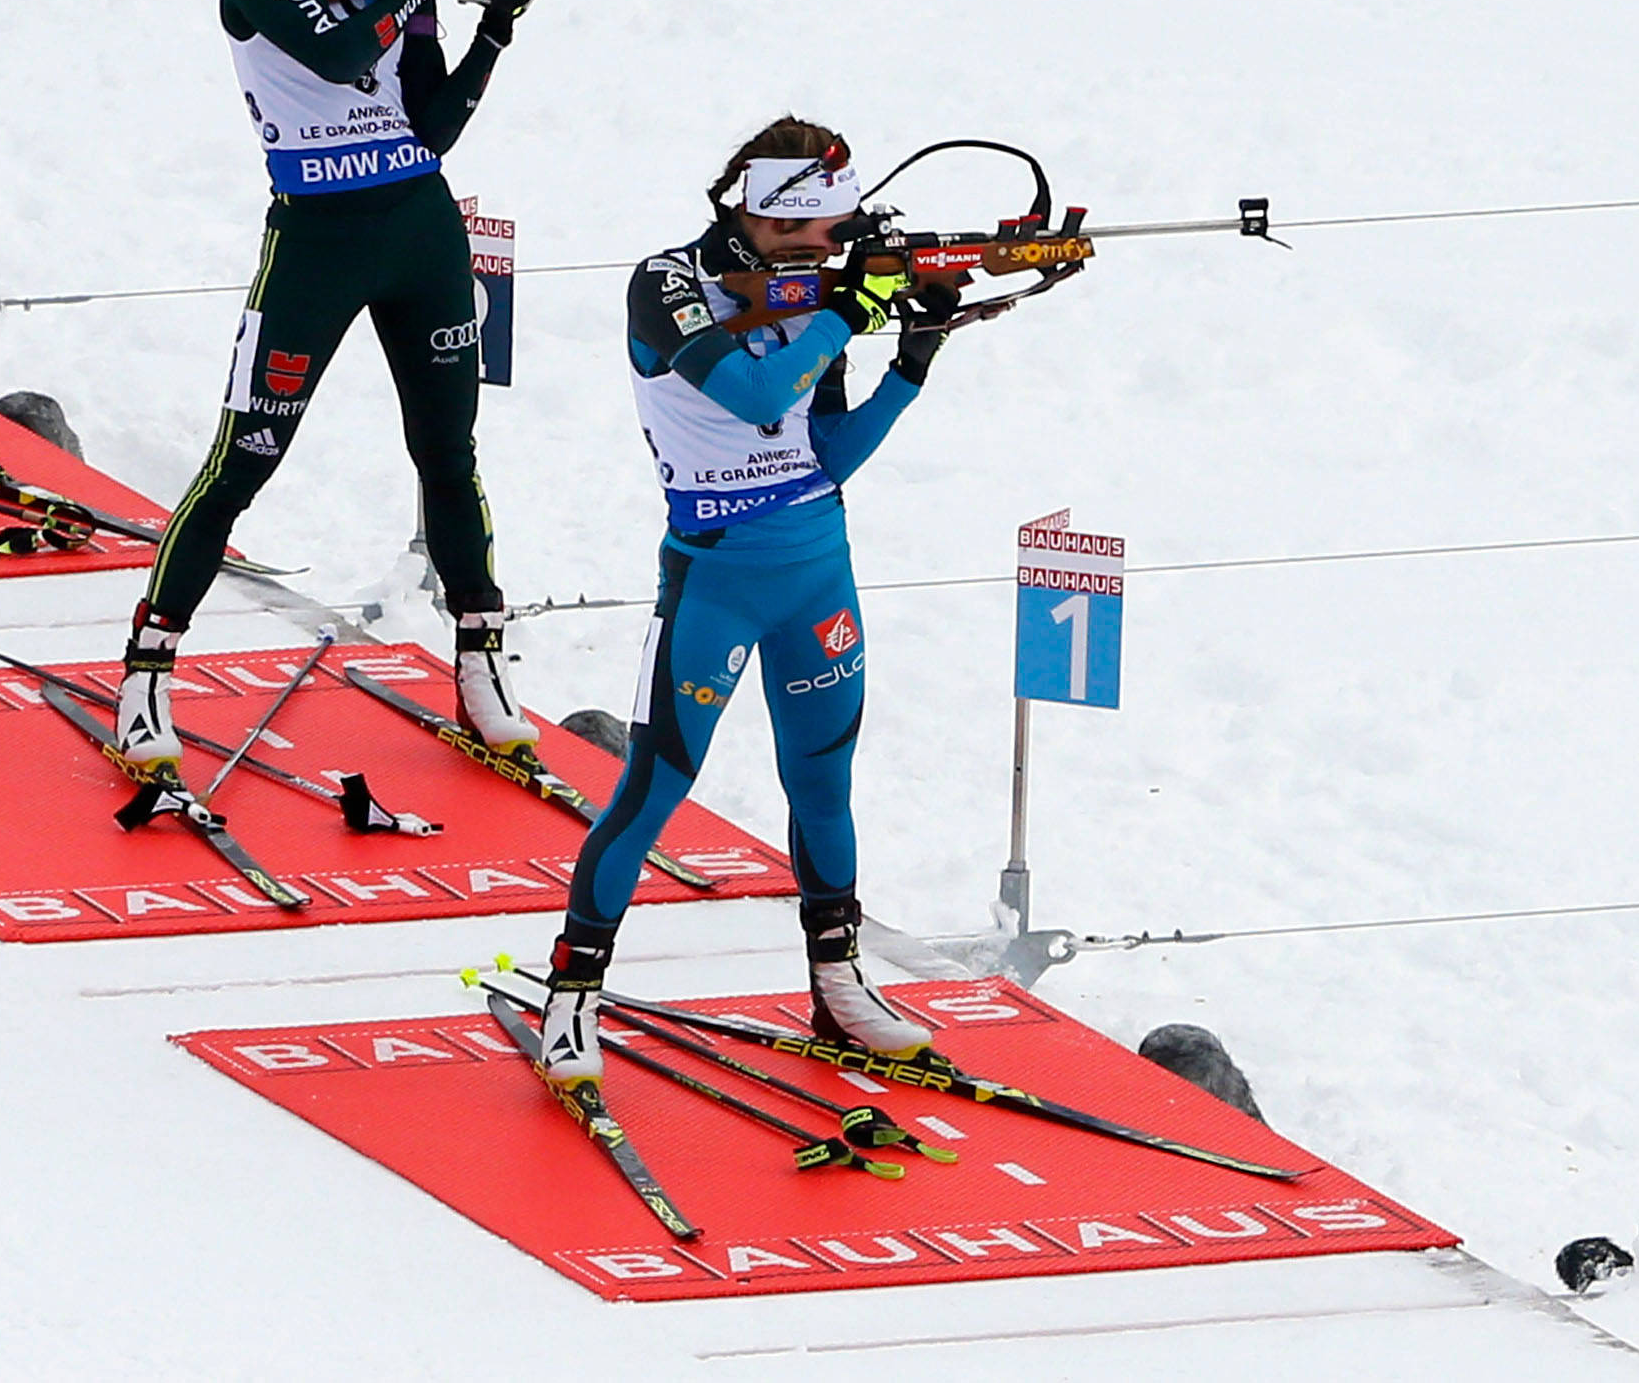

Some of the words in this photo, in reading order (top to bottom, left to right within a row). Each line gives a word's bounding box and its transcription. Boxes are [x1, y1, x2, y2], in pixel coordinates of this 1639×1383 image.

[299, 126, 322, 141] LE
[326, 119, 410, 138] GRAND-BO
[300, 149, 380, 184] BMW
[385, 143, 437, 173] xDri
[431, 354, 460, 364] Audi
[236, 437, 280, 457] adidas
[695, 470, 716, 484] LE
[1020, 531, 1122, 556] BAUHAUS
[1019, 569, 1122, 593] BAUHAUS
[1050, 594, 1089, 700] 1
[437, 726, 530, 787] FISCHER
[234, 996, 1020, 1070] BAUS
[773, 1037, 952, 1093] FISCHER
[586, 1204, 1388, 1279] BAUHAUS
